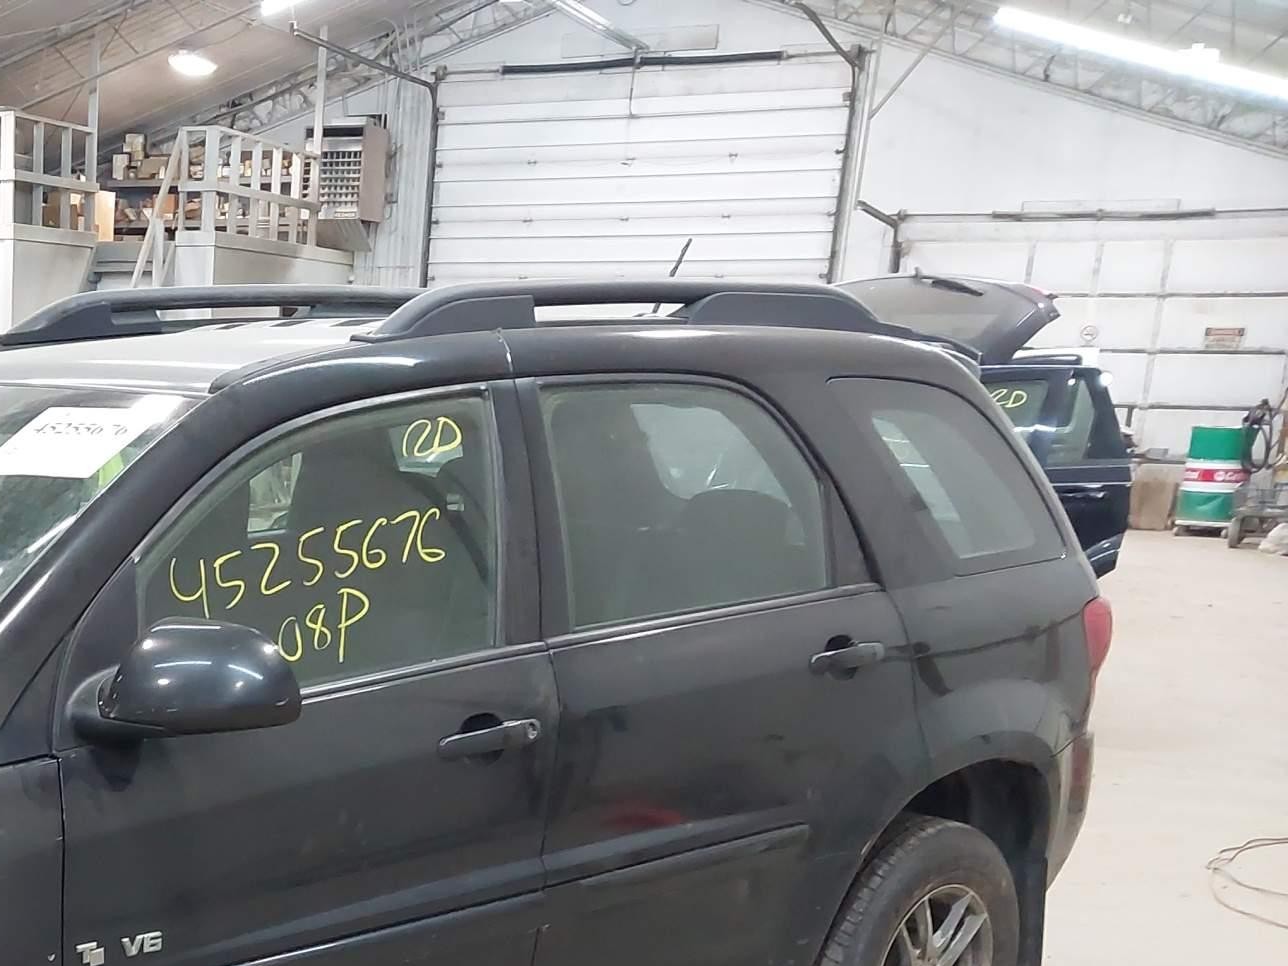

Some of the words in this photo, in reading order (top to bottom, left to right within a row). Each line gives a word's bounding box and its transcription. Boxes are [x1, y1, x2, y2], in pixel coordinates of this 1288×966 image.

[169, 507, 447, 620] 45255676
[277, 587, 370, 664] 08P
[121, 931, 163, 957] V6
